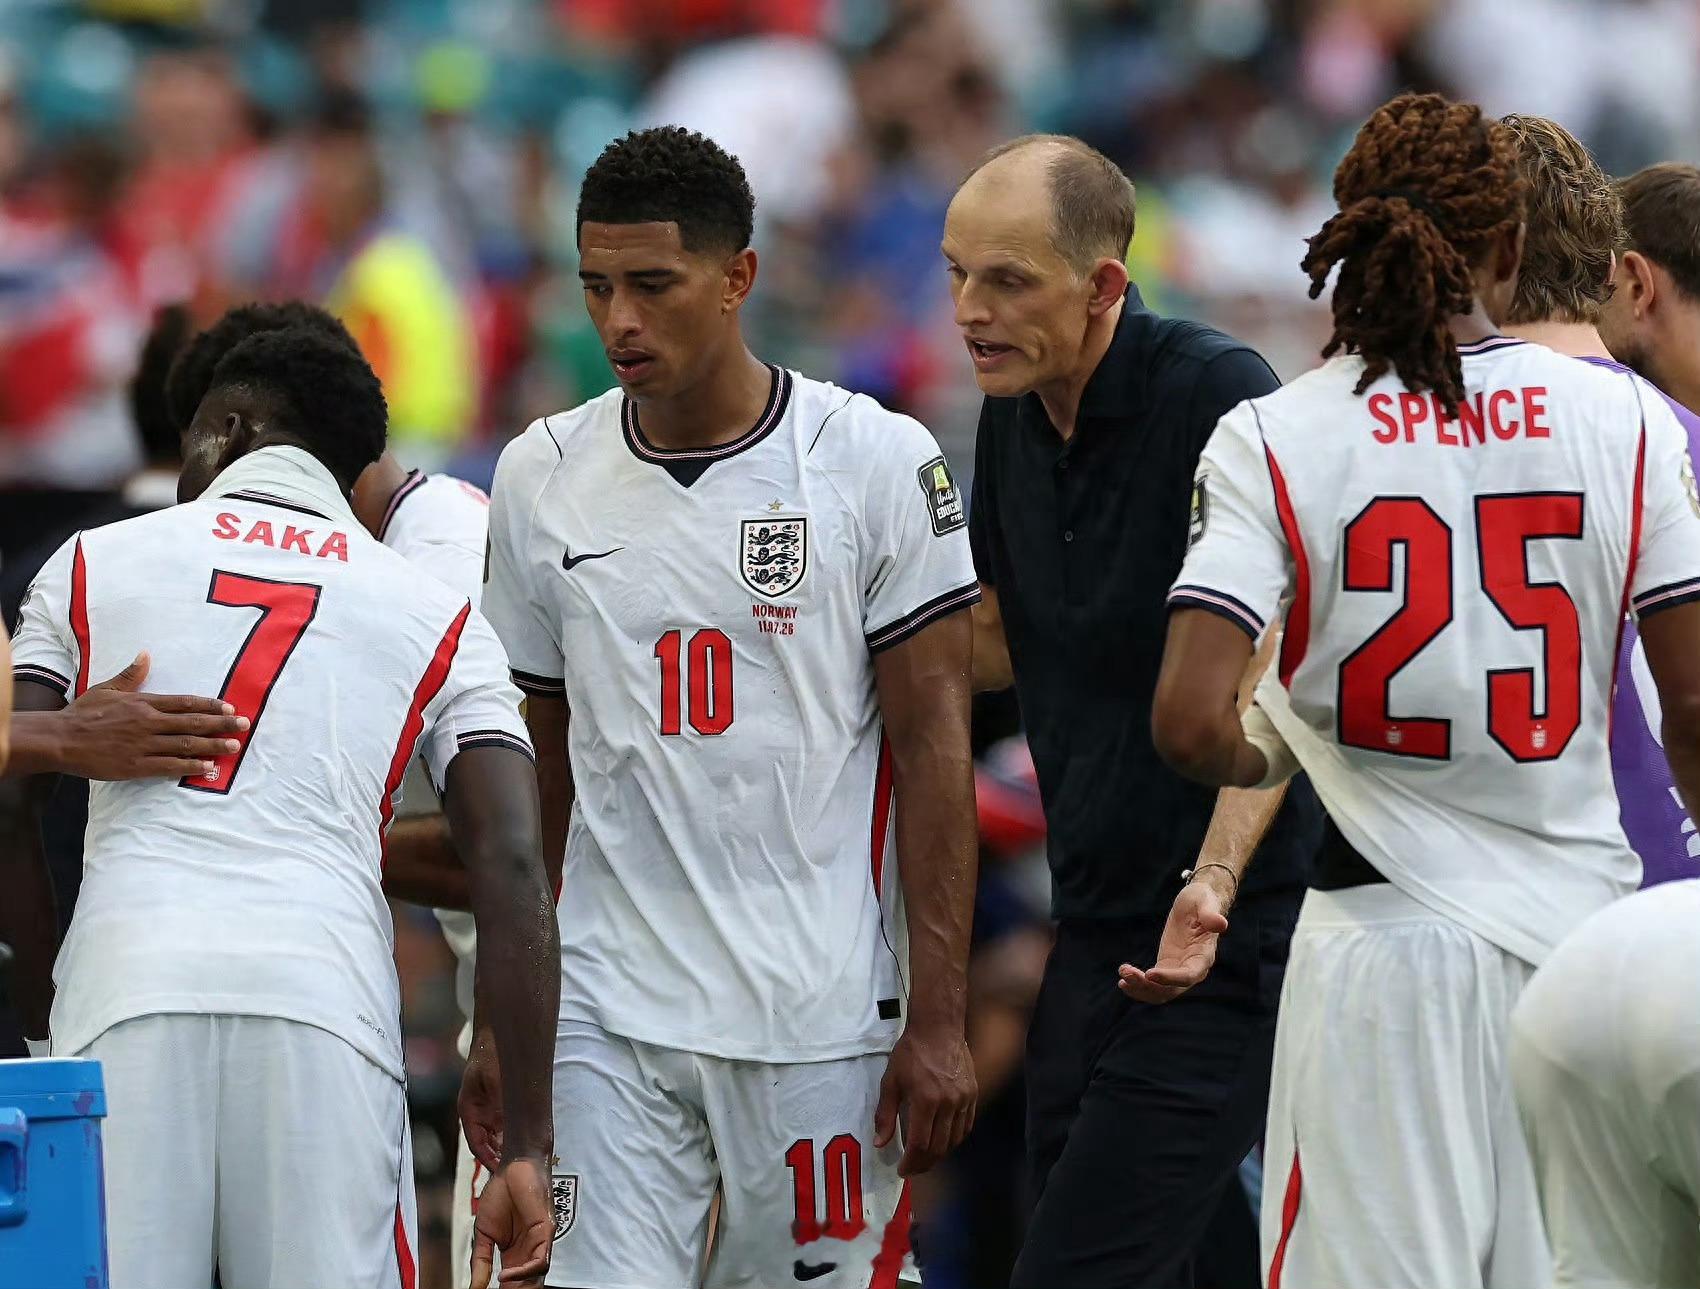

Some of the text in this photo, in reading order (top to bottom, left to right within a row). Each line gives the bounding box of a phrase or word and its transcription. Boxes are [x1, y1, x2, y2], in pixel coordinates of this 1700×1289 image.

[1368, 387, 1551, 447] SPENCE
[212, 512, 349, 563] SAKA
[752, 604, 798, 619] NORWAY
[1338, 492, 1586, 763] 25
[178, 568, 322, 796] 7
[654, 628, 734, 736] 10
[784, 1133, 866, 1246] 10
